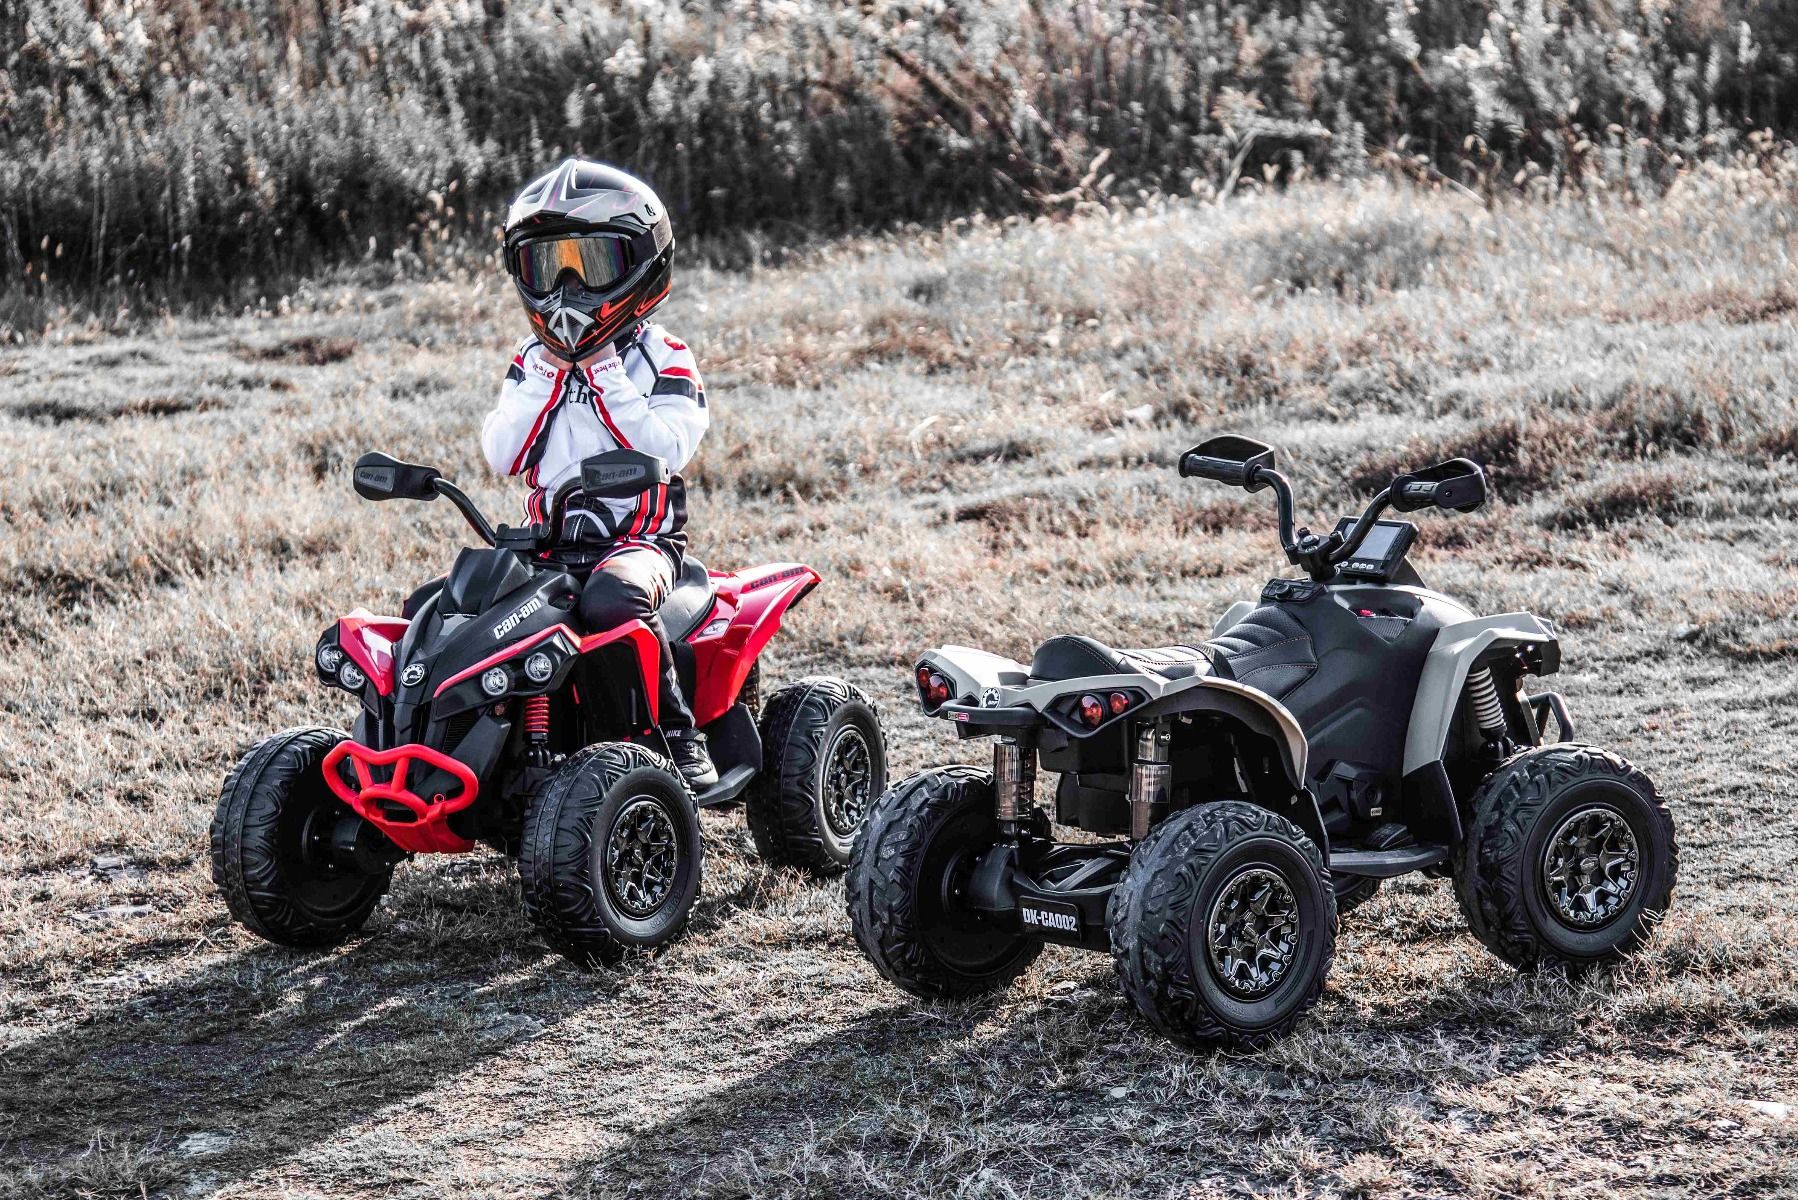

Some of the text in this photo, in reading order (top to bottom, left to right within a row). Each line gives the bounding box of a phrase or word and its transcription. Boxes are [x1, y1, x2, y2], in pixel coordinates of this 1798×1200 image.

[751, 566, 804, 589] can-am
[493, 597, 542, 640] can-am
[1022, 907, 1078, 932] DK-CA002
